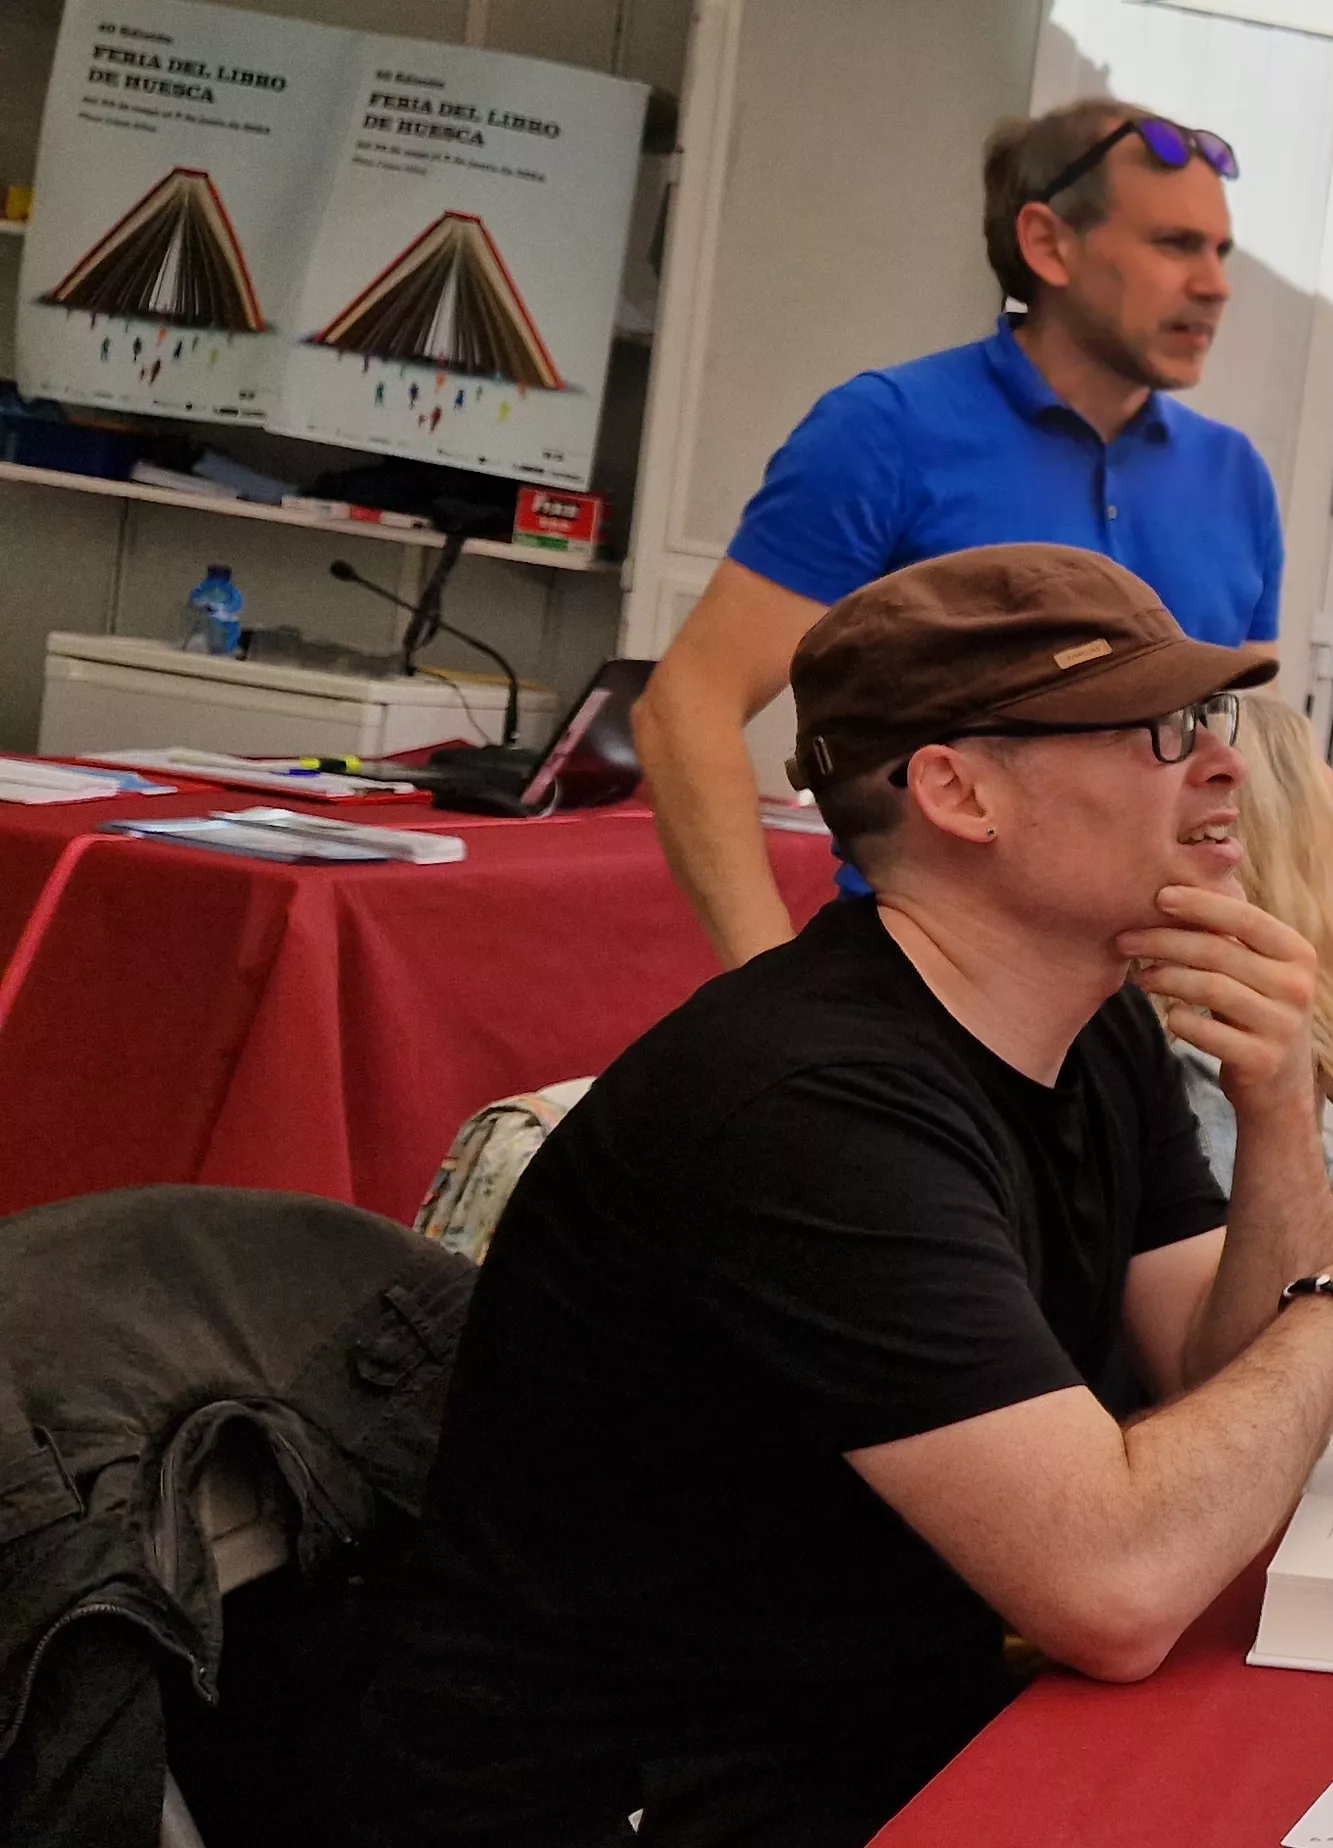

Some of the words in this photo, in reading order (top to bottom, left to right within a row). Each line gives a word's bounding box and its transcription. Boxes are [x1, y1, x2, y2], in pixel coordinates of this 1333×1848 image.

[88, 67, 119, 86] DE
[124, 73, 215, 104] HUESCA
[92, 44, 161, 69] FERIA
[168, 56, 211, 79] DEL
[217, 66, 288, 93] LIBRO
[363, 114, 392, 130] DE
[397, 118, 485, 147] HUESCA
[368, 92, 433, 114] FERIA
[439, 102, 481, 124] DEL
[487, 109, 561, 139] LIBRO
